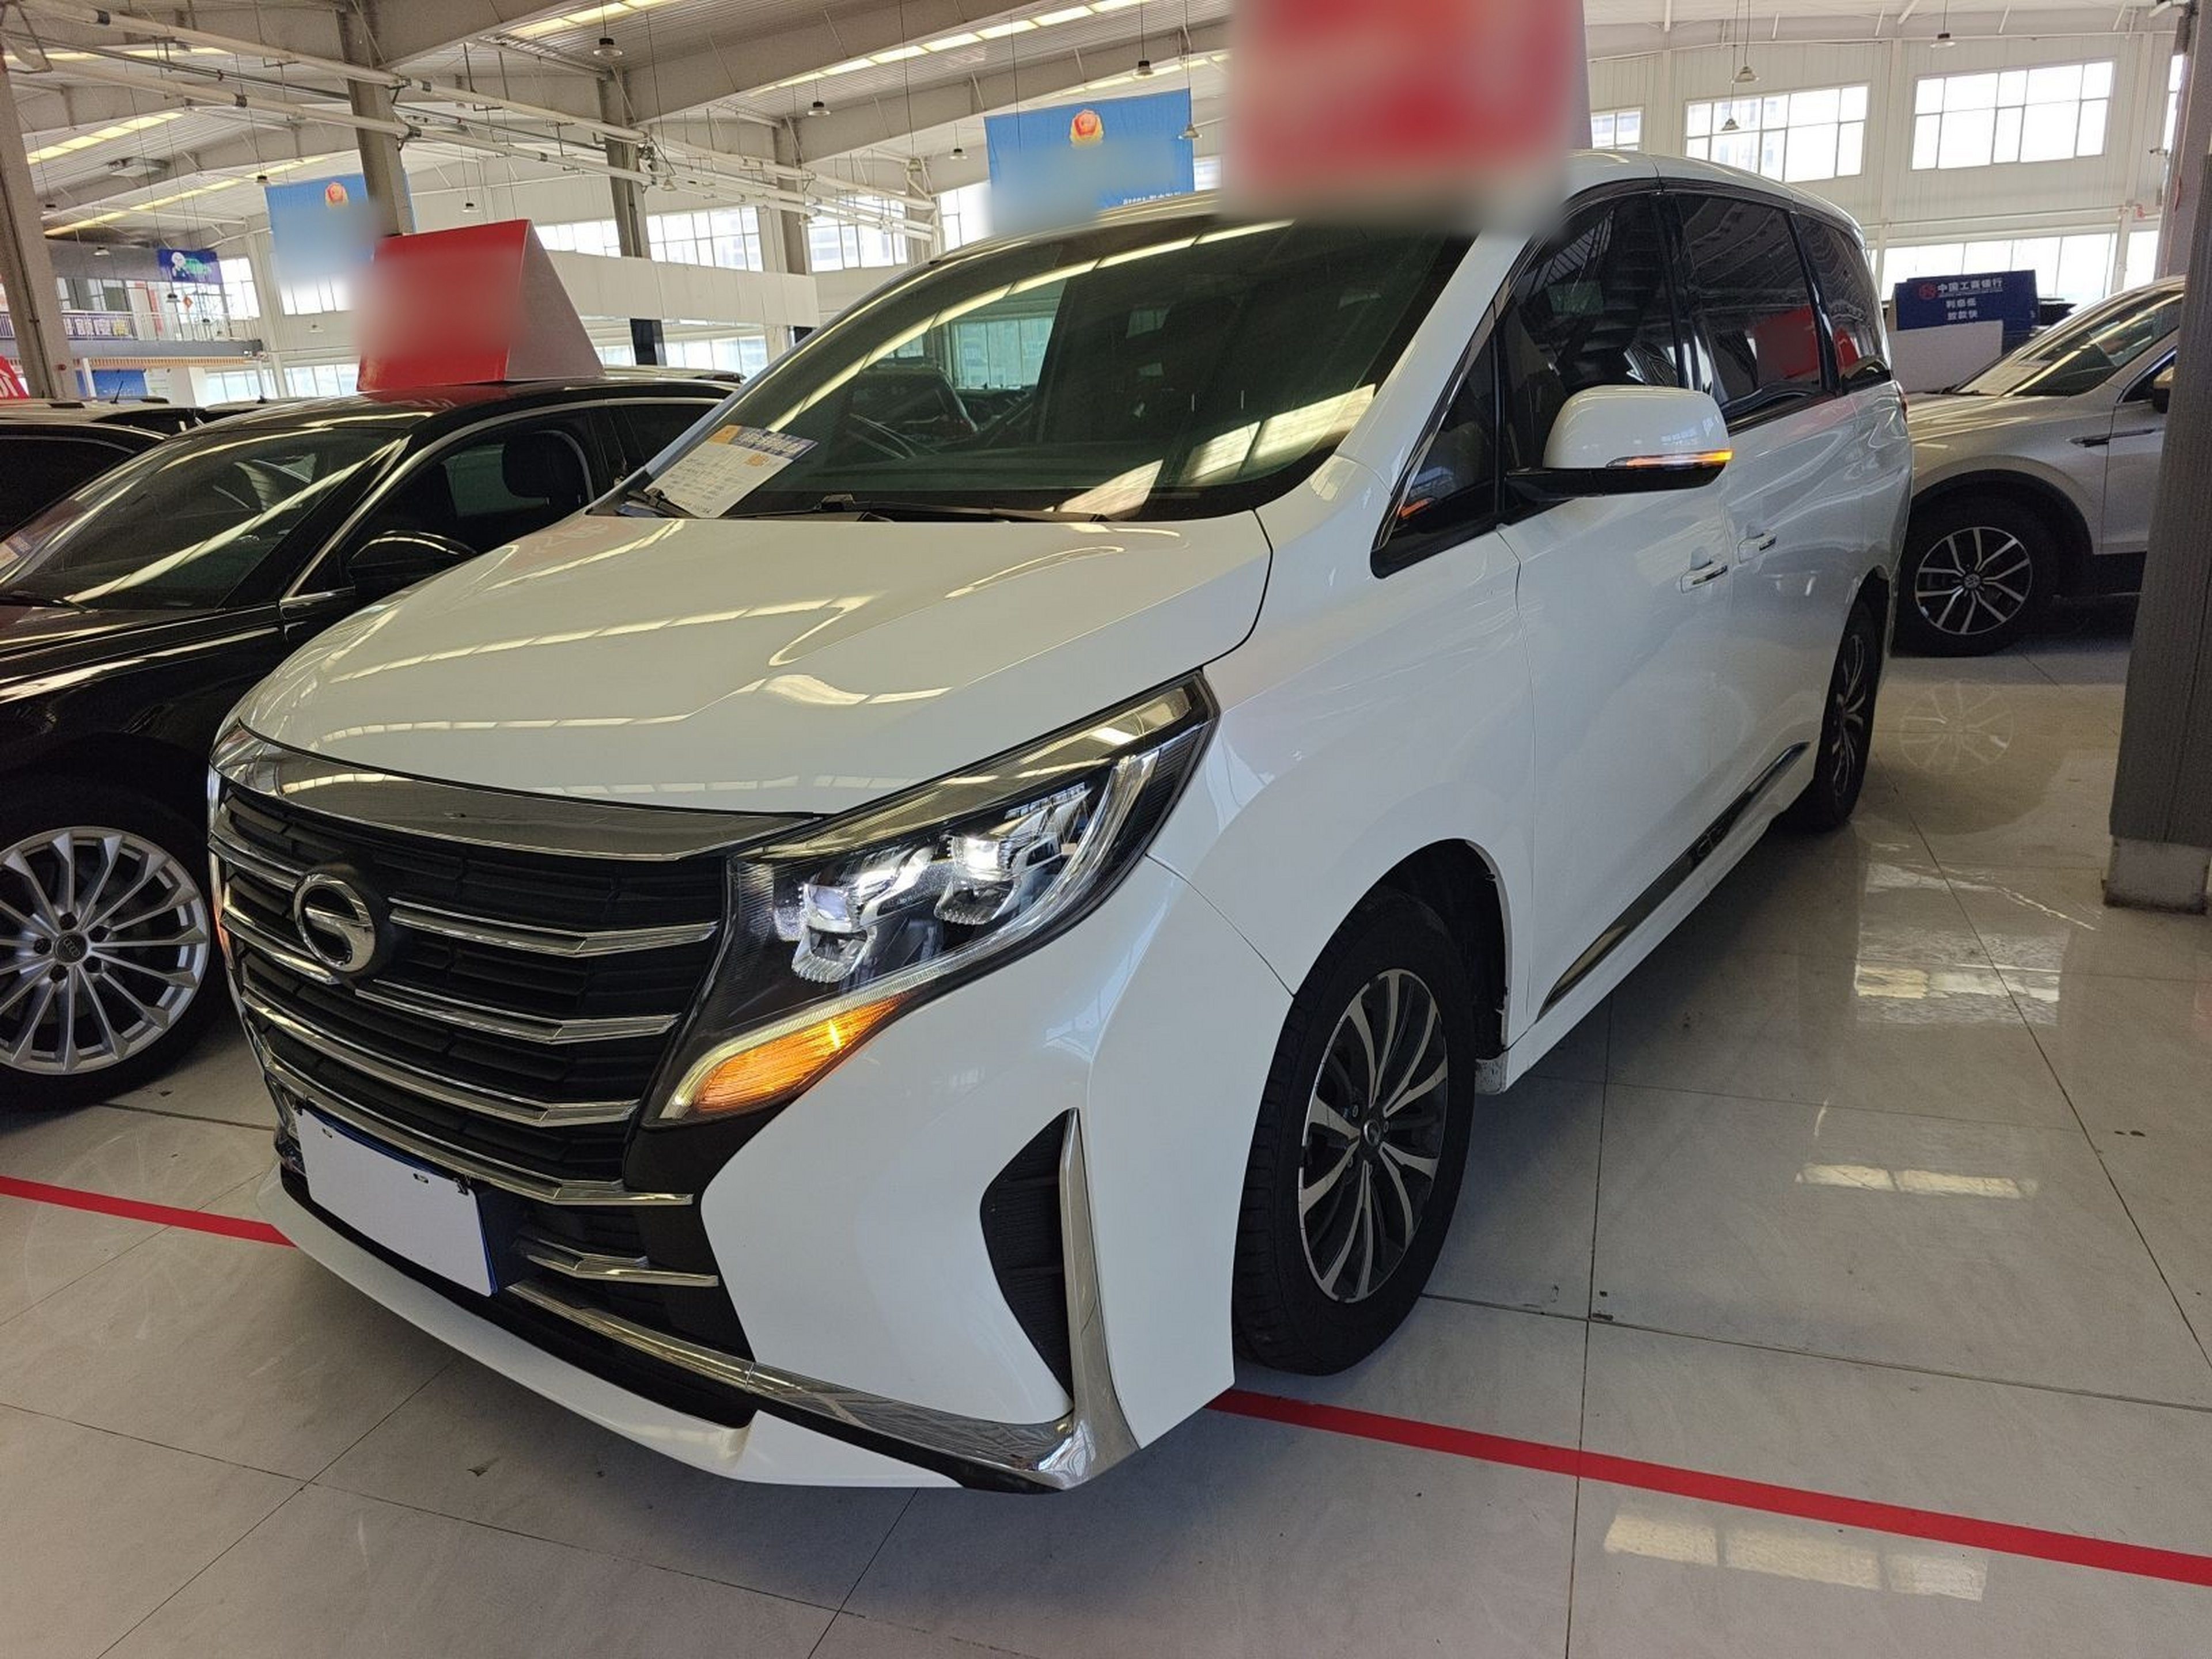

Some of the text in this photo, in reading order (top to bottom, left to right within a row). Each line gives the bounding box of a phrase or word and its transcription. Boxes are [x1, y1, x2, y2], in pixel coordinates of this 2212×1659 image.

[1937, 278, 2003, 293] 中国工商银行
